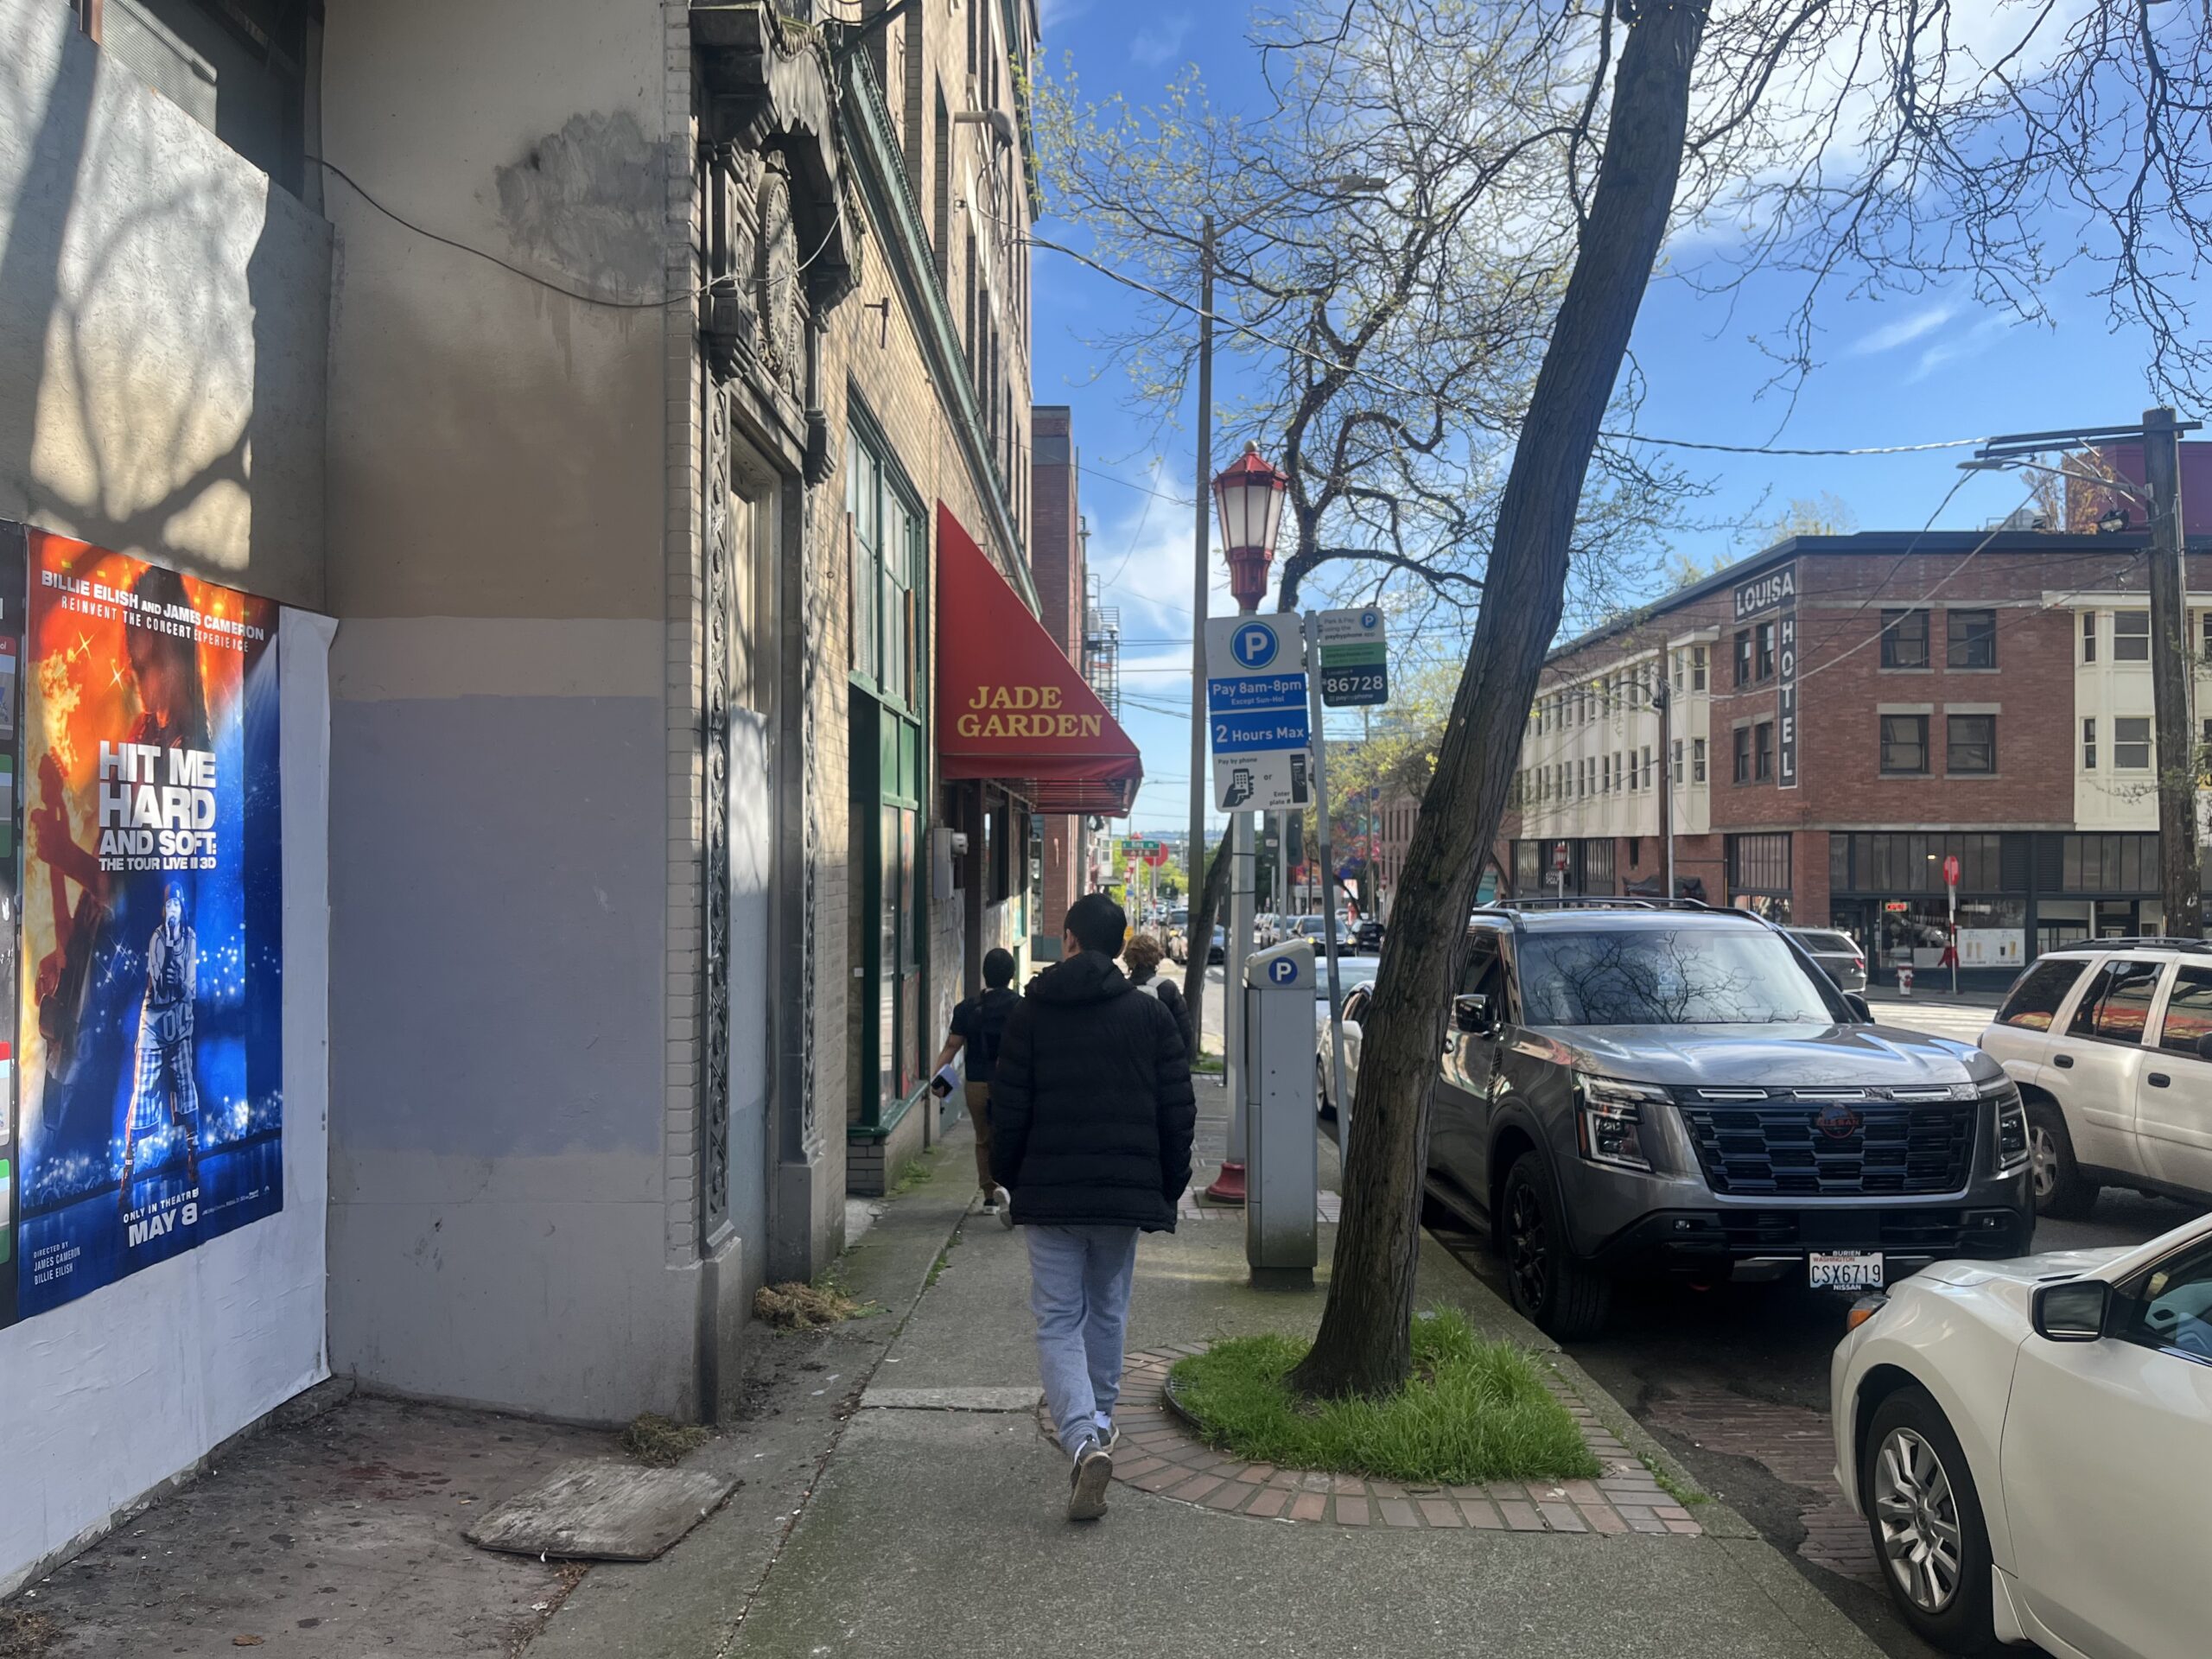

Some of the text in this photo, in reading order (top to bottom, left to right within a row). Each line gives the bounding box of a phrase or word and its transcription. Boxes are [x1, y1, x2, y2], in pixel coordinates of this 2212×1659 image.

[41, 569, 264, 641] BILLIE EILISH AND JAMES CAMERON
[1736, 571, 1795, 616] LOUISA
[61, 595, 117, 620] REINVENT
[123, 610, 142, 627] THE
[146, 616, 191, 639] CONCERT
[1245, 632, 1268, 661] P
[1213, 679, 1302, 697] Pay 8am-8pm
[1326, 675, 1383, 693] 86728
[969, 686, 1062, 709] JADE
[1231, 696, 1285, 706] Except Sun-Hol
[1781, 620, 1795, 776] HOTEL
[957, 714, 1103, 737] GARDEN
[1216, 724, 1305, 743] 2 Hours Max
[99, 741, 216, 789] HIT ME
[99, 782, 216, 830] HARD
[99, 830, 217, 856] AND SOFT:
[99, 857, 124, 872] THE
[126, 856, 161, 871] TOUR
[163, 856, 188, 871] LIVE
[200, 856, 216, 869] 3D
[1276, 962, 1293, 982] P
[123, 1207, 145, 1224] ONLY
[148, 1202, 157, 1214] IN
[129, 1209, 177, 1248] MAY
[181, 1202, 198, 1226] 8
[34, 1241, 69, 1259] DIRECTED BY
[34, 1246, 81, 1272] JAMES CAMERON
[34, 1262, 73, 1286] BILLIE EILISH
[1812, 1264, 1881, 1284] CSX6719
